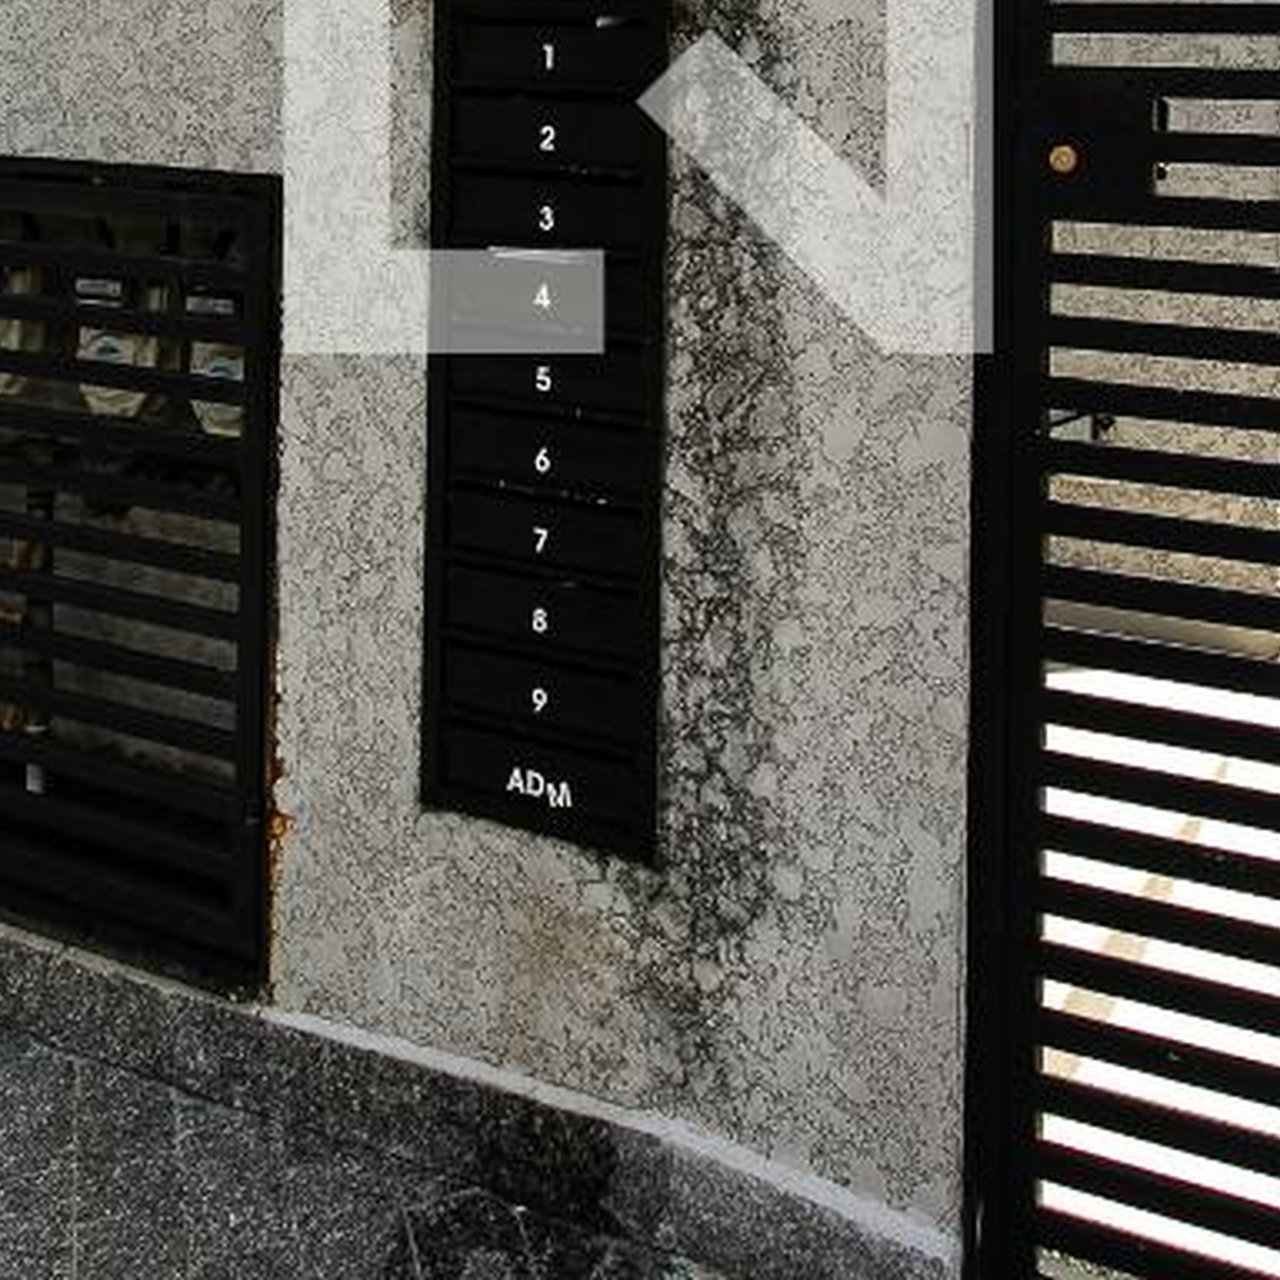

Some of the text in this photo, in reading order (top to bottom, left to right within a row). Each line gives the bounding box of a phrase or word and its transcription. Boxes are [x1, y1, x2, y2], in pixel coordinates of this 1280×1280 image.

[543, 44, 554, 70] 1
[540, 125, 556, 151] 2
[539, 205, 555, 231] 3
[533, 283, 551, 309] 4
[535, 366, 552, 392] 5
[534, 447, 551, 473] 6
[533, 527, 548, 552] 7
[532, 608, 548, 633] 8
[531, 688, 548, 713] 9
[506, 766, 573, 809] ADM
